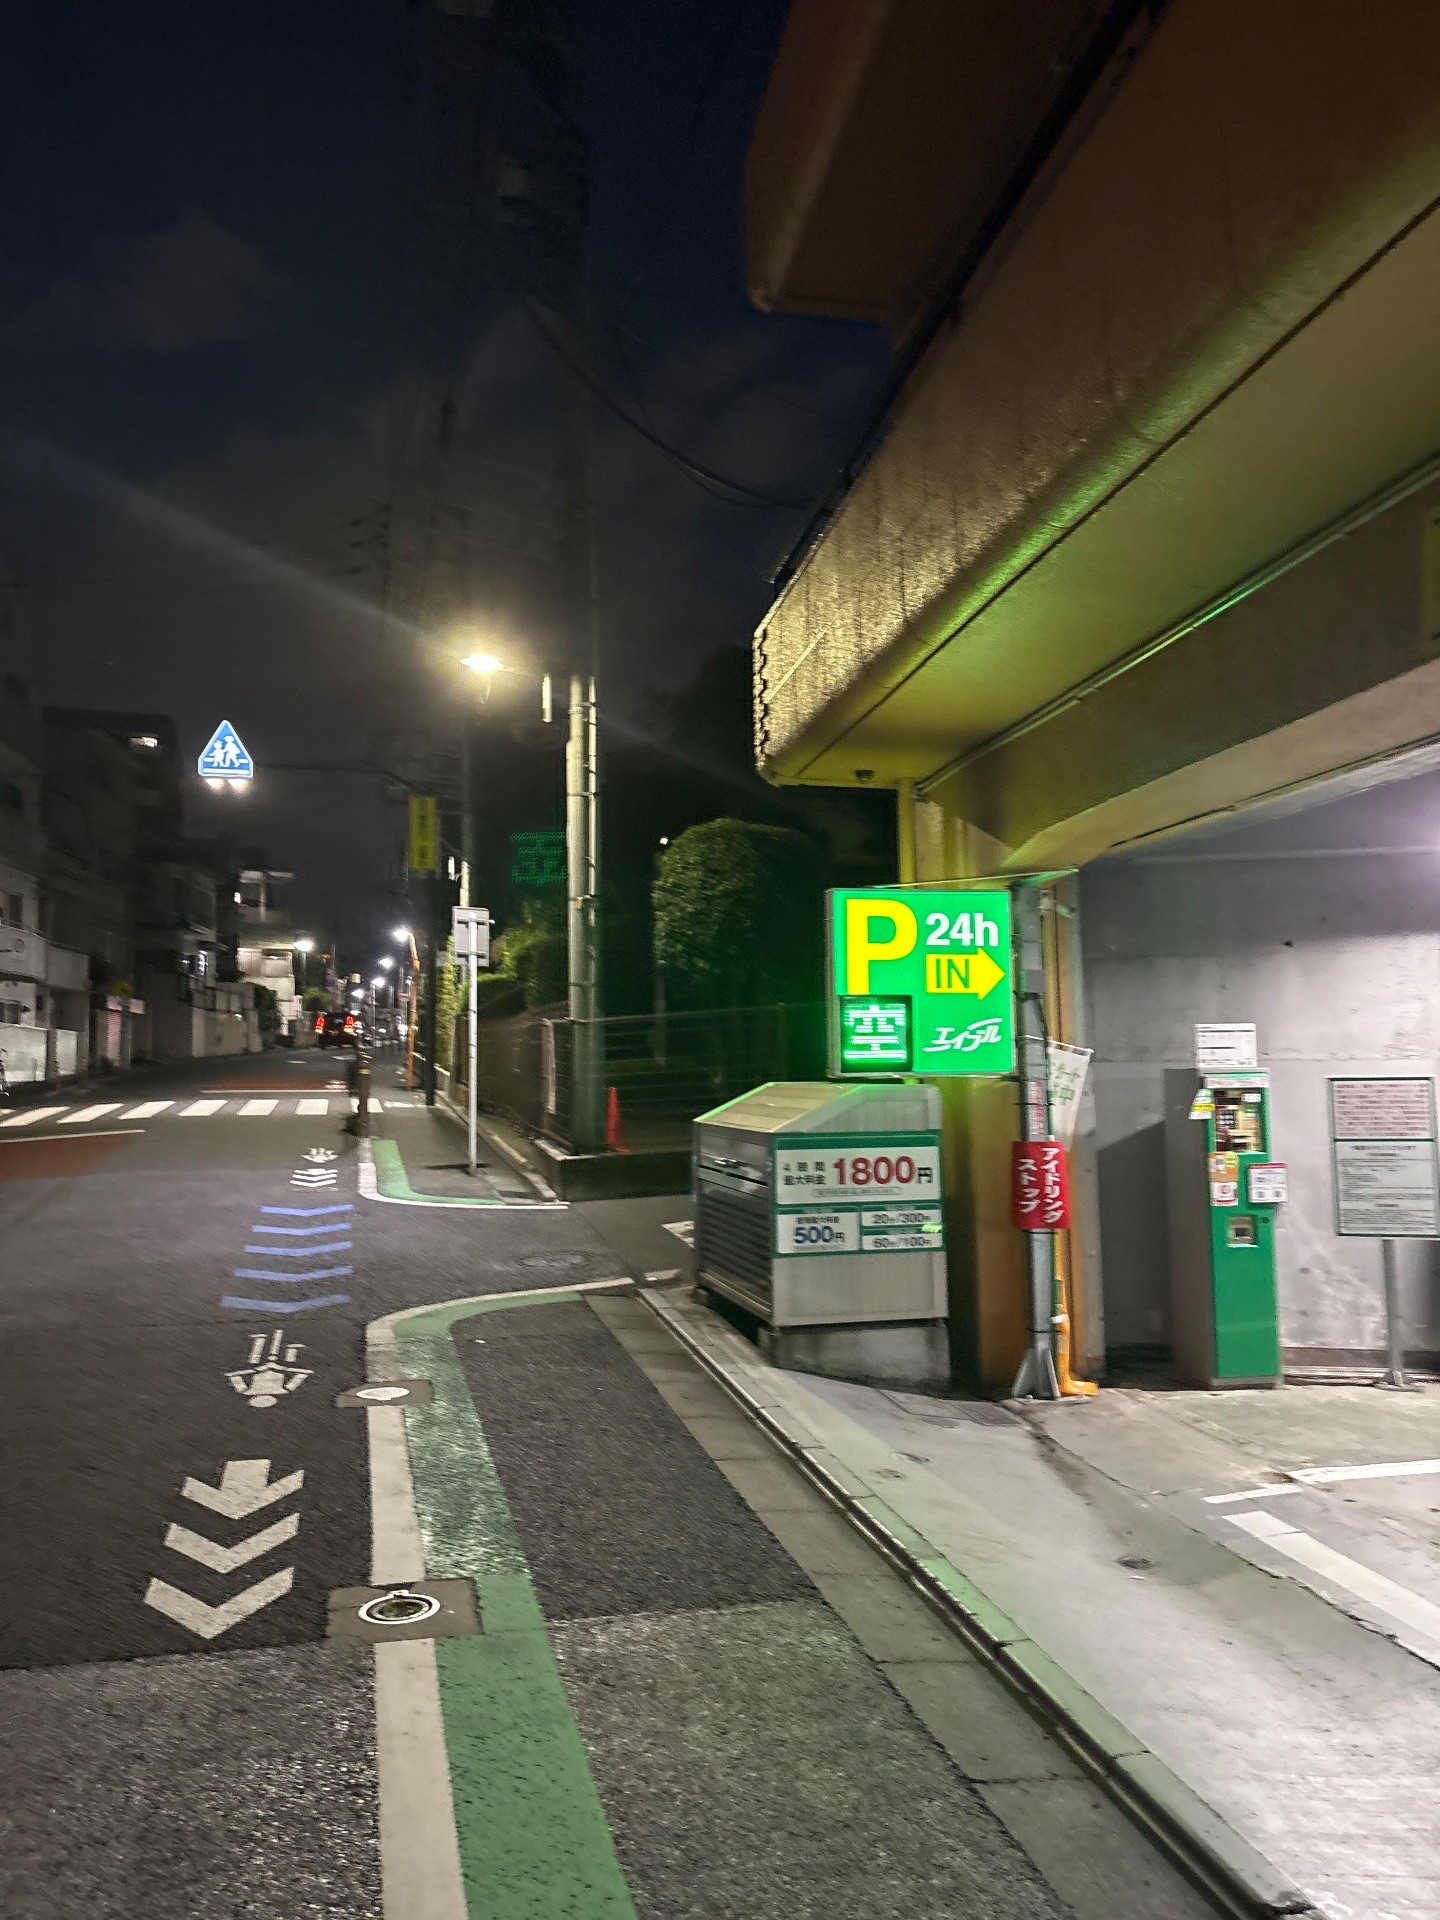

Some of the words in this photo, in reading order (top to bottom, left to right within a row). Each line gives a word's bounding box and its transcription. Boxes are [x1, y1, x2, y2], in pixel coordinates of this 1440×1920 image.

[846, 898, 918, 996] P
[925, 912, 999, 947] 24h
[935, 958, 971, 989] IN
[844, 1004, 907, 1061] 空
[832, 1155, 934, 1186] 1800円
[1018, 1158, 1040, 1213] ストップ
[1040, 1146, 1065, 1224] アイドリング
[793, 1226, 846, 1244] 500円
